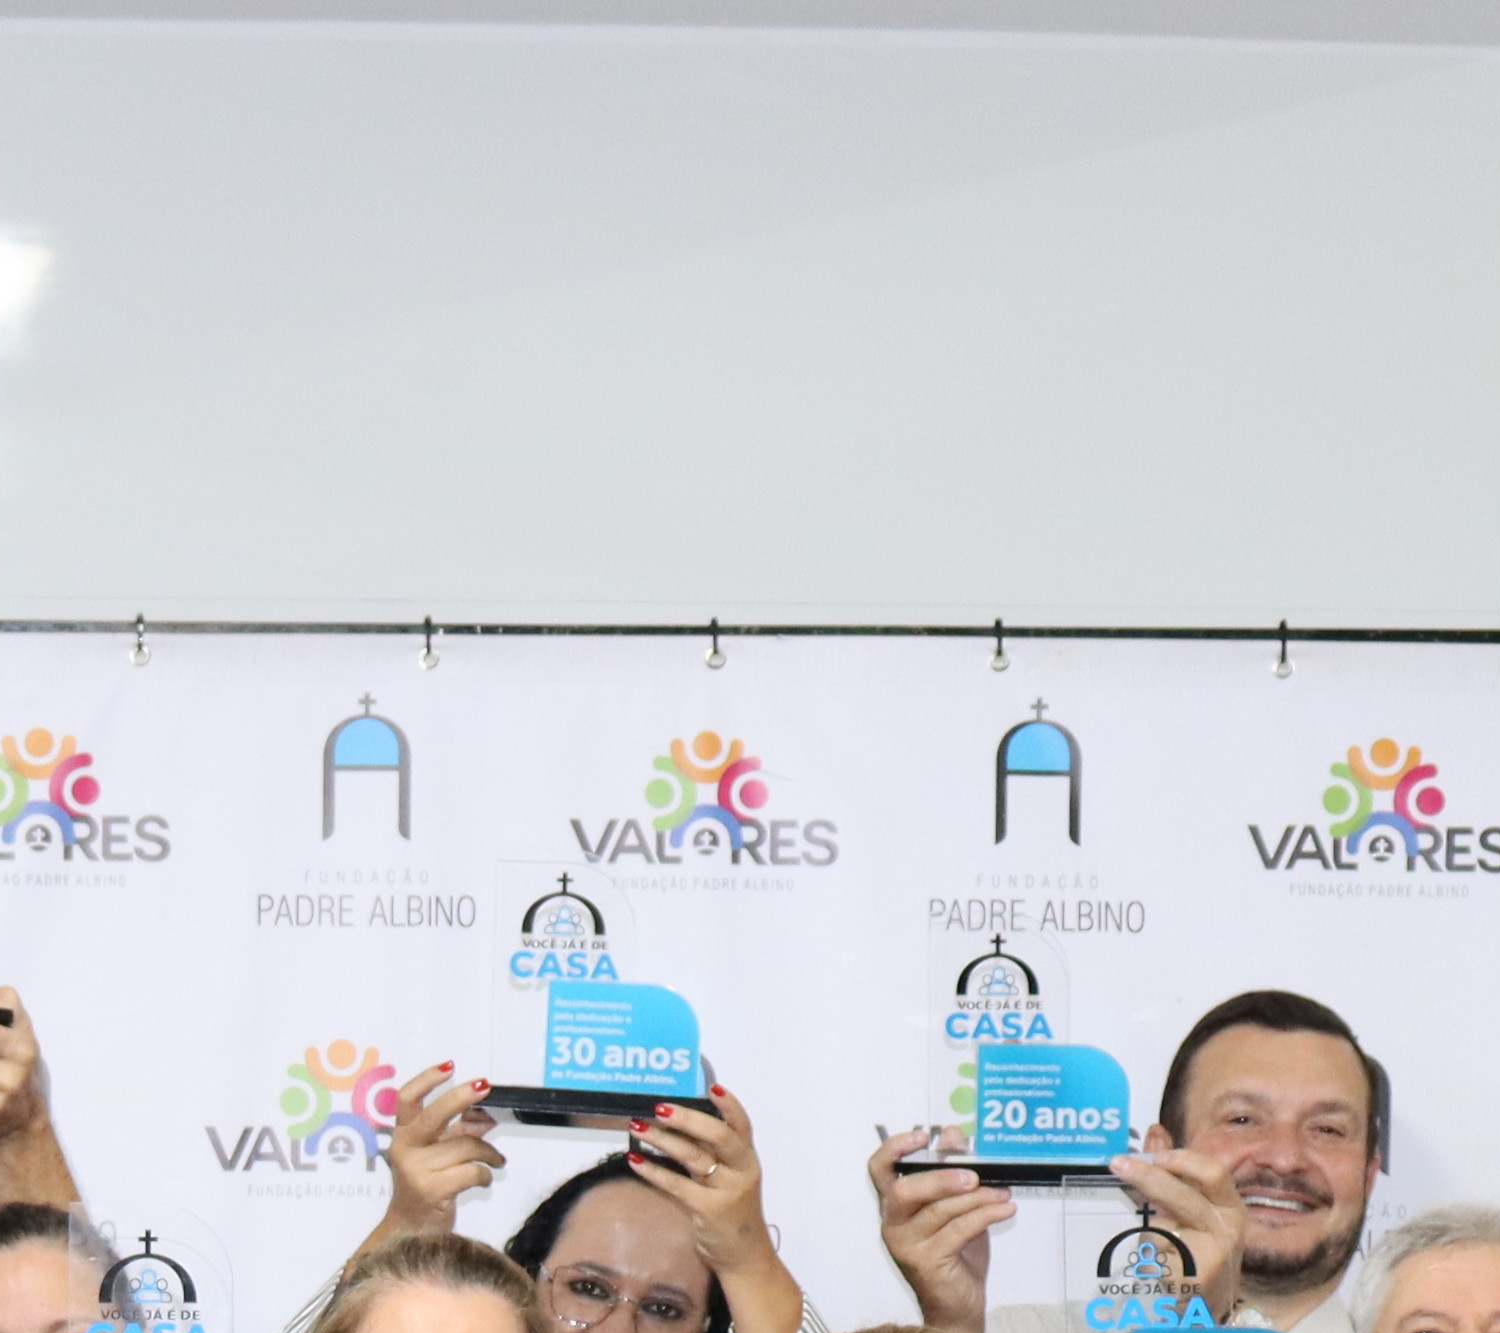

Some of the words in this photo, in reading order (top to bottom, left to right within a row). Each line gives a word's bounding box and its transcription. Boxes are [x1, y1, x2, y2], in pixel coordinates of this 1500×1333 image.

[257, 895, 355, 927] PADRE
[370, 895, 477, 928] ALBINO
[930, 899, 1025, 931] PADRE
[1039, 900, 1146, 934] ALBINO
[509, 951, 619, 980] CASA
[945, 1012, 1053, 1039] CASA
[551, 1036, 596, 1067] 30
[603, 1044, 692, 1072] anos
[983, 1100, 1028, 1129] 20
[1034, 1107, 1121, 1131] anos
[1084, 1296, 1216, 1331] CASA
